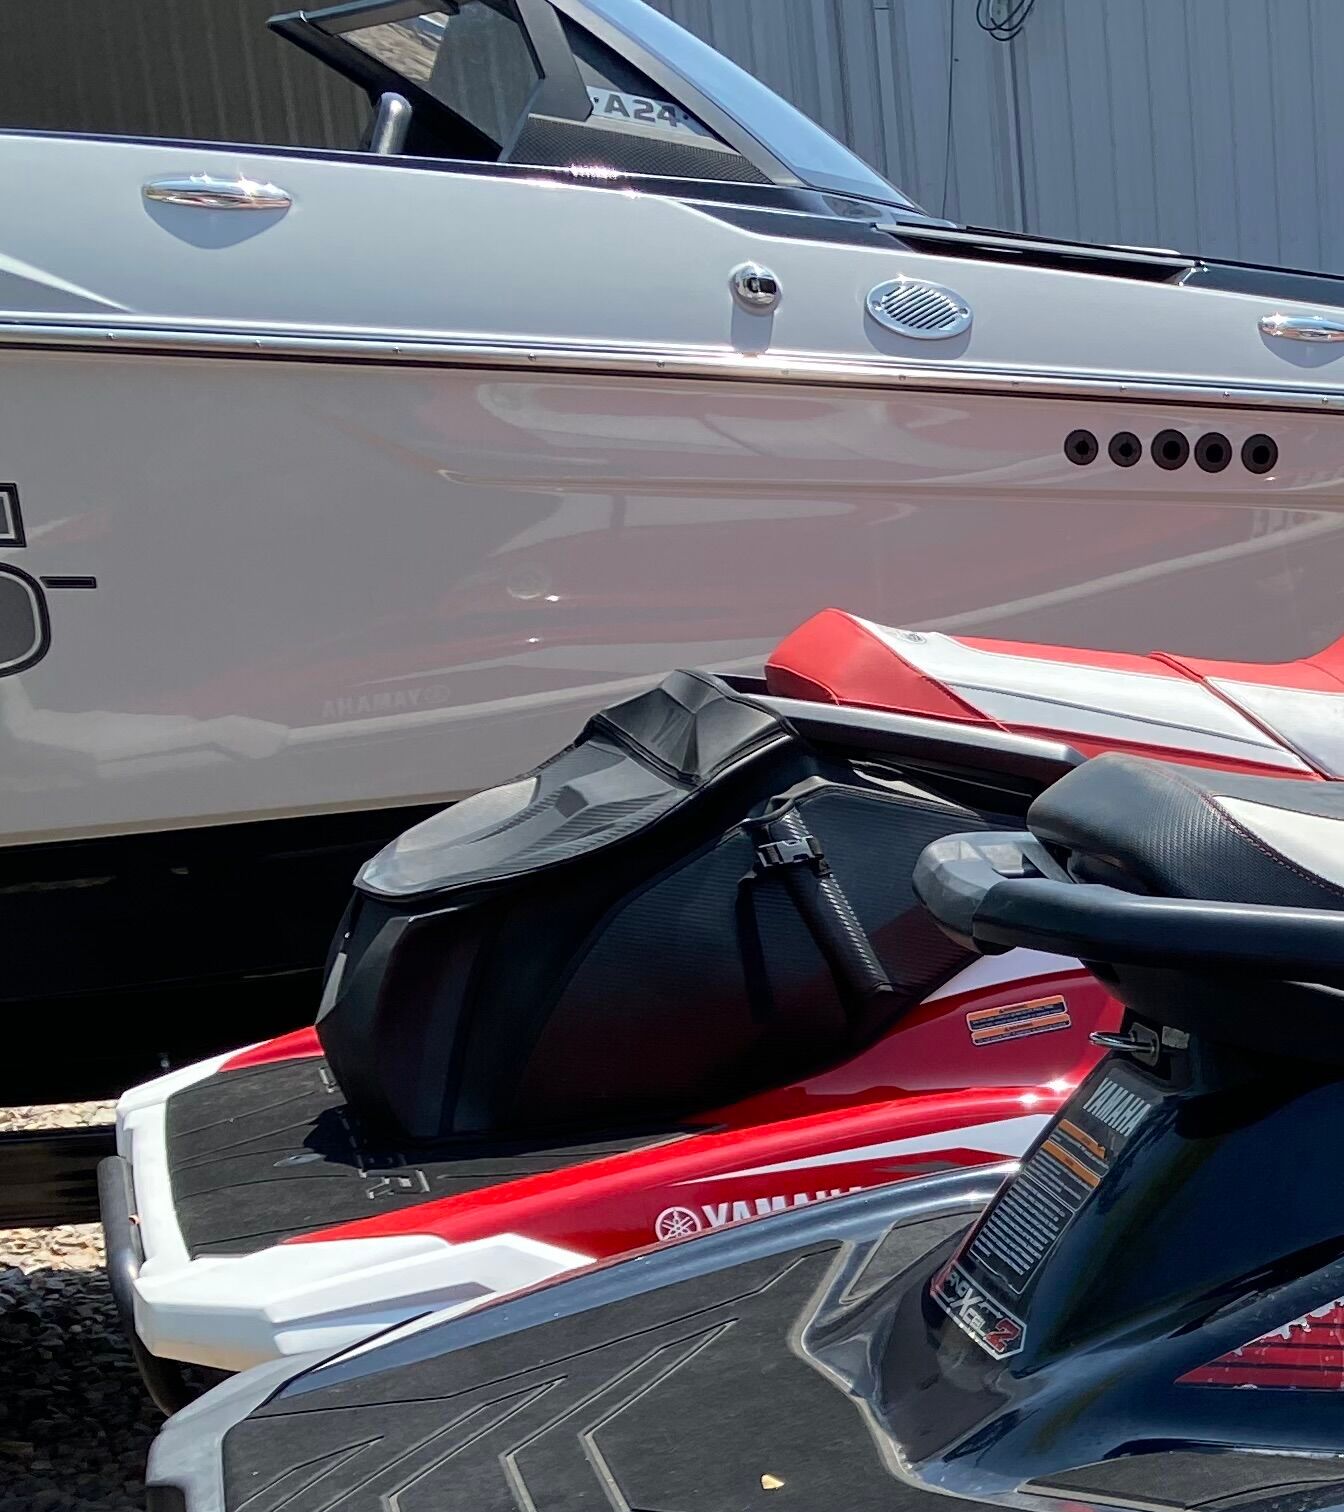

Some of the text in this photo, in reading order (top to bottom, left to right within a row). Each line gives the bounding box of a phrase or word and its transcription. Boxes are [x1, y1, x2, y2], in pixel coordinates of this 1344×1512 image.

[603, 93, 678, 128] A24
[1082, 1076, 1151, 1137] YAMAHA
[702, 1186, 862, 1228] YAM
